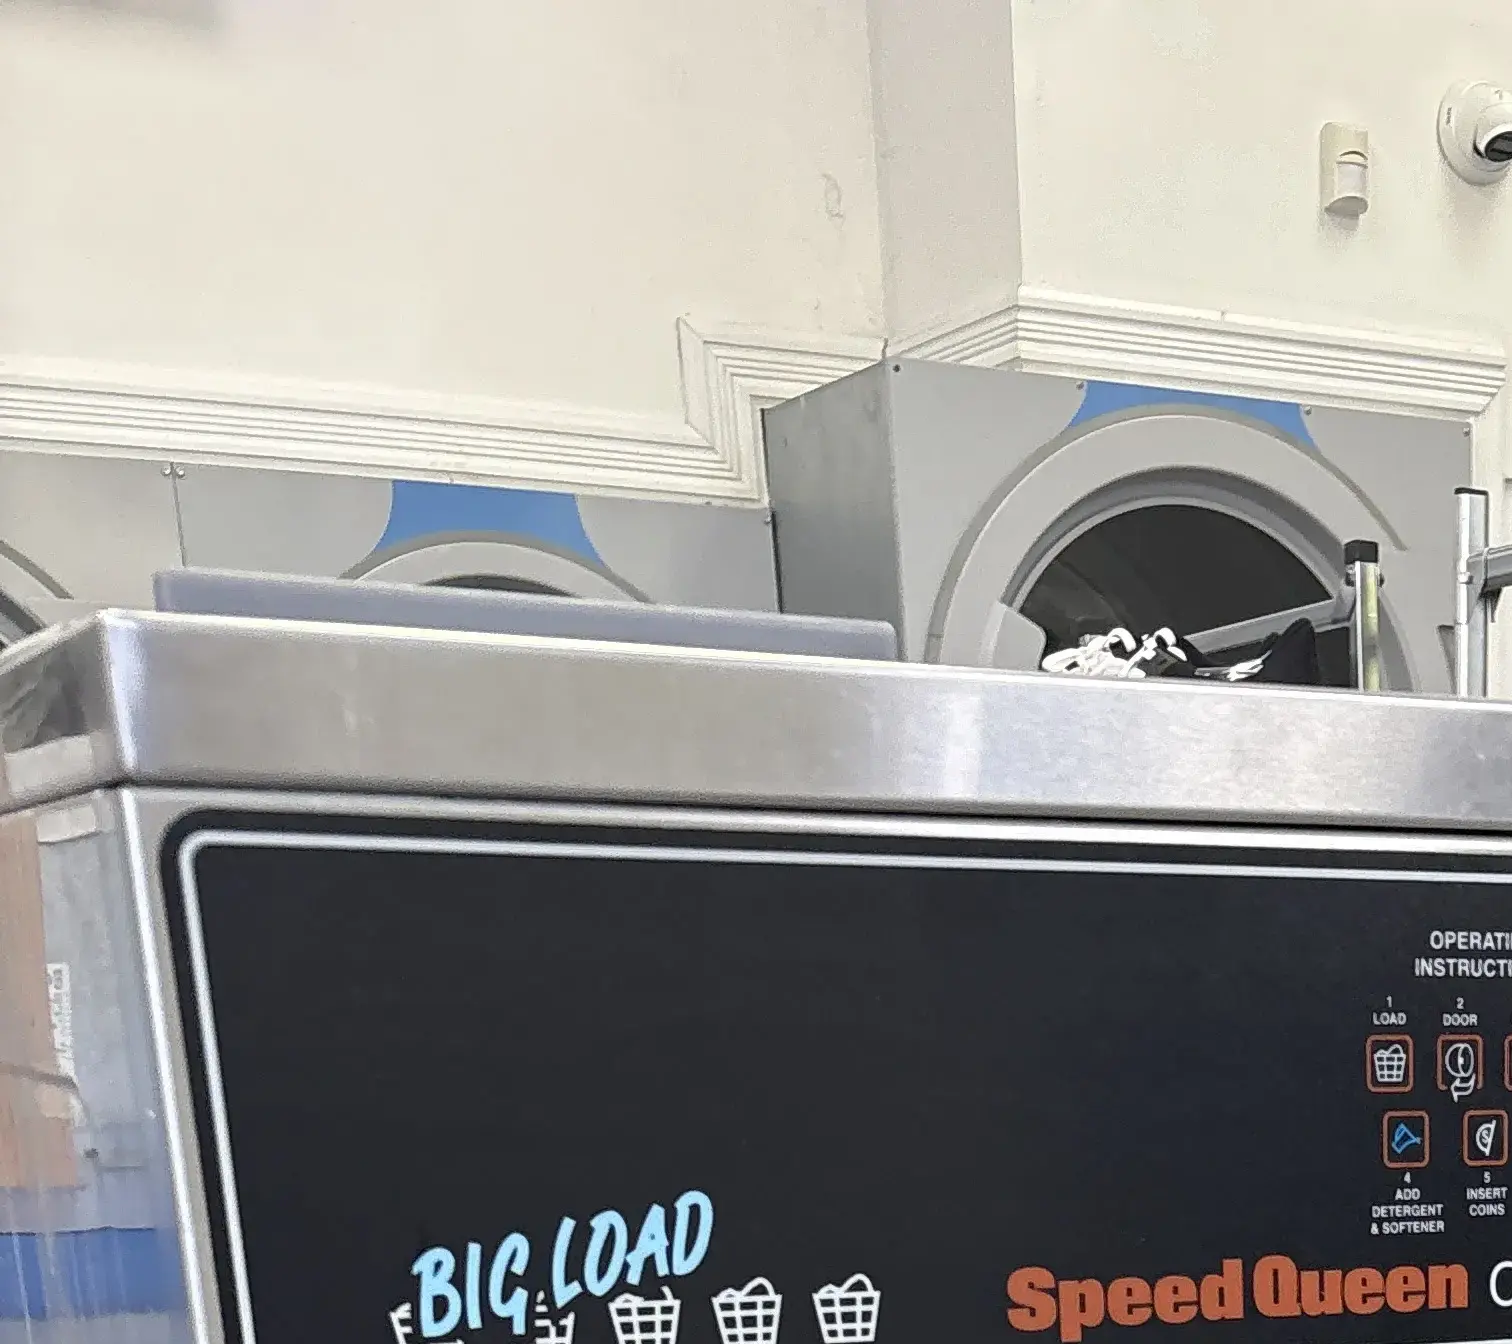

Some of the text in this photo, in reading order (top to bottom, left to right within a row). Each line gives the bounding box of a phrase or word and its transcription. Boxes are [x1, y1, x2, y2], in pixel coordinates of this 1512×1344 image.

[1386, 995, 1393, 1007] 1
[1456, 997, 1465, 1010] 2
[1372, 1012, 1407, 1026] LOAD
[1442, 1013, 1478, 1027] DOOR
[1403, 1171, 1412, 1184] 4
[1483, 1171, 1491, 1183] 5
[1394, 1188, 1421, 1201] ADD
[1466, 1187, 1508, 1200] INSERT
[1371, 1203, 1444, 1218] DETERGENT
[1469, 1203, 1506, 1217] COINS
[1370, 1219, 1445, 1235] & SOFTENER
[410, 1190, 713, 1338] BIG LOAD
[1006, 1257, 1245, 1343] Speed
[1253, 1254, 1470, 1319] Queen
